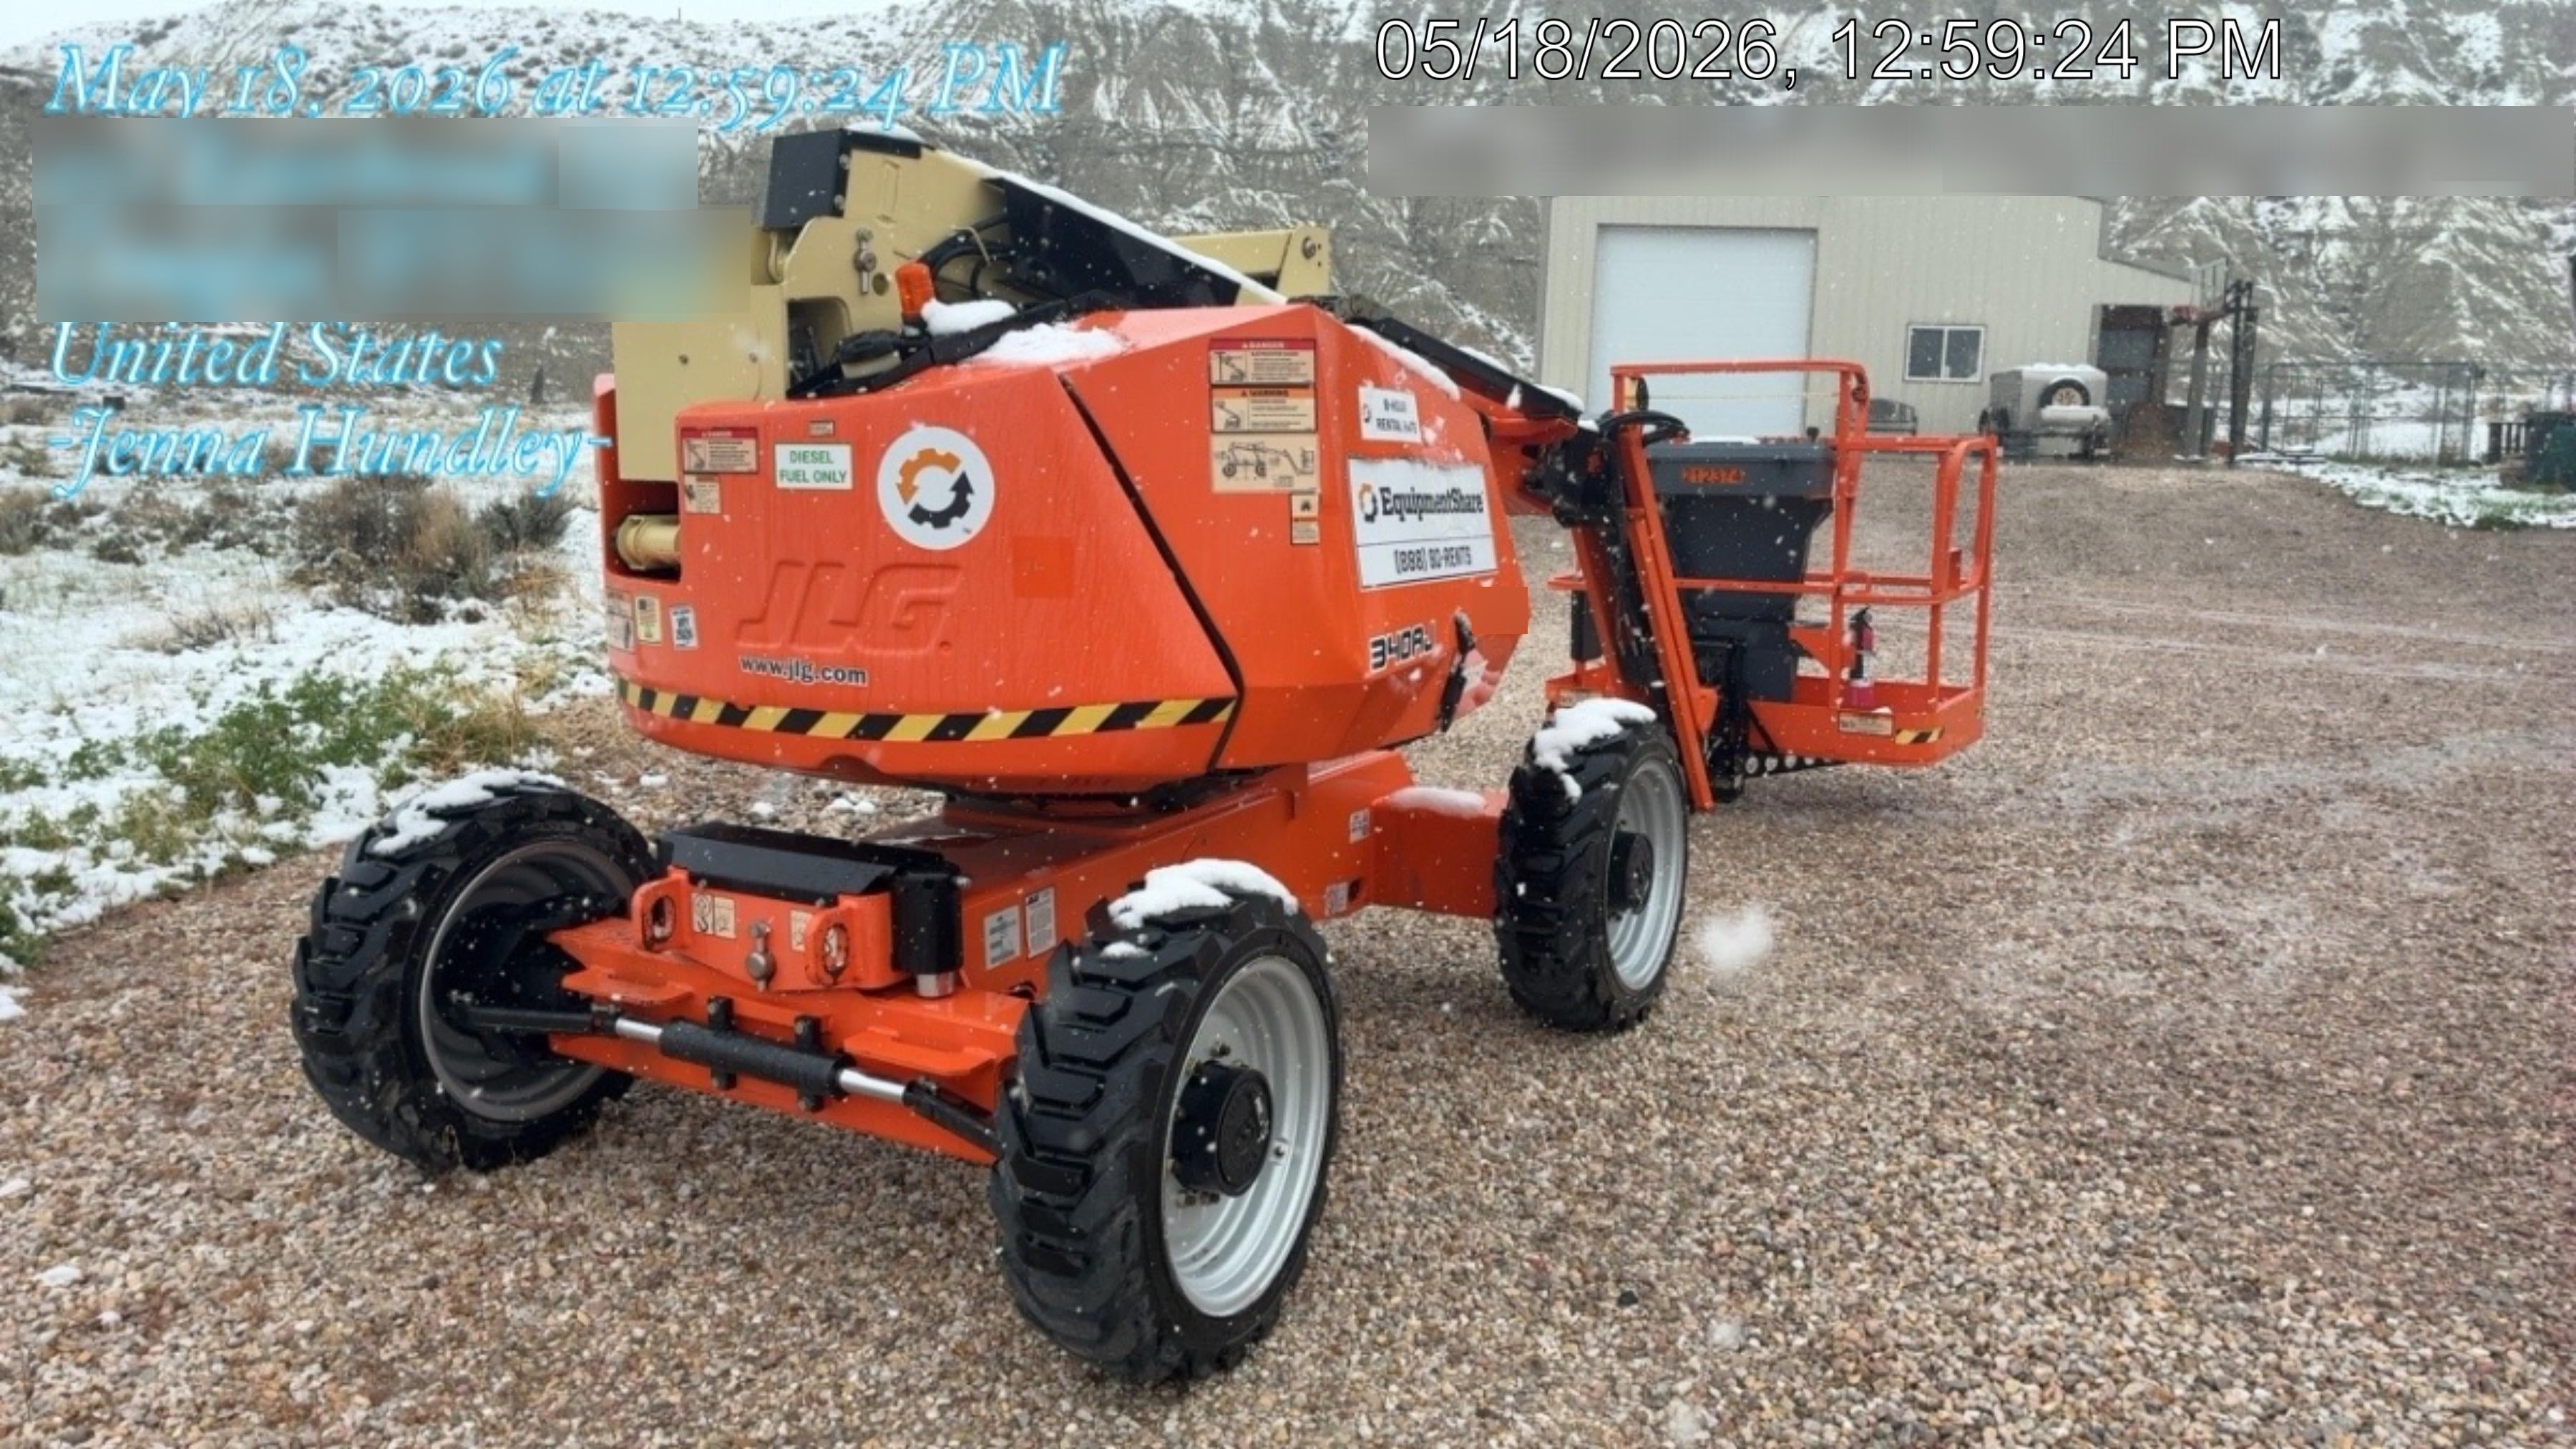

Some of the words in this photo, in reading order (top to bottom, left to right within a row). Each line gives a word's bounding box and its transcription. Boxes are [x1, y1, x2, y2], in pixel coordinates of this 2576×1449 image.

[789, 450, 834, 464] DIESEL
[779, 469, 809, 484] FUEL
[813, 469, 847, 484] ONLY
[1378, 487, 1484, 522] EquipmentShare
[1393, 547, 1428, 575] (888)
[734, 560, 964, 656] JLG
[739, 655, 868, 687] www.jlg.com
